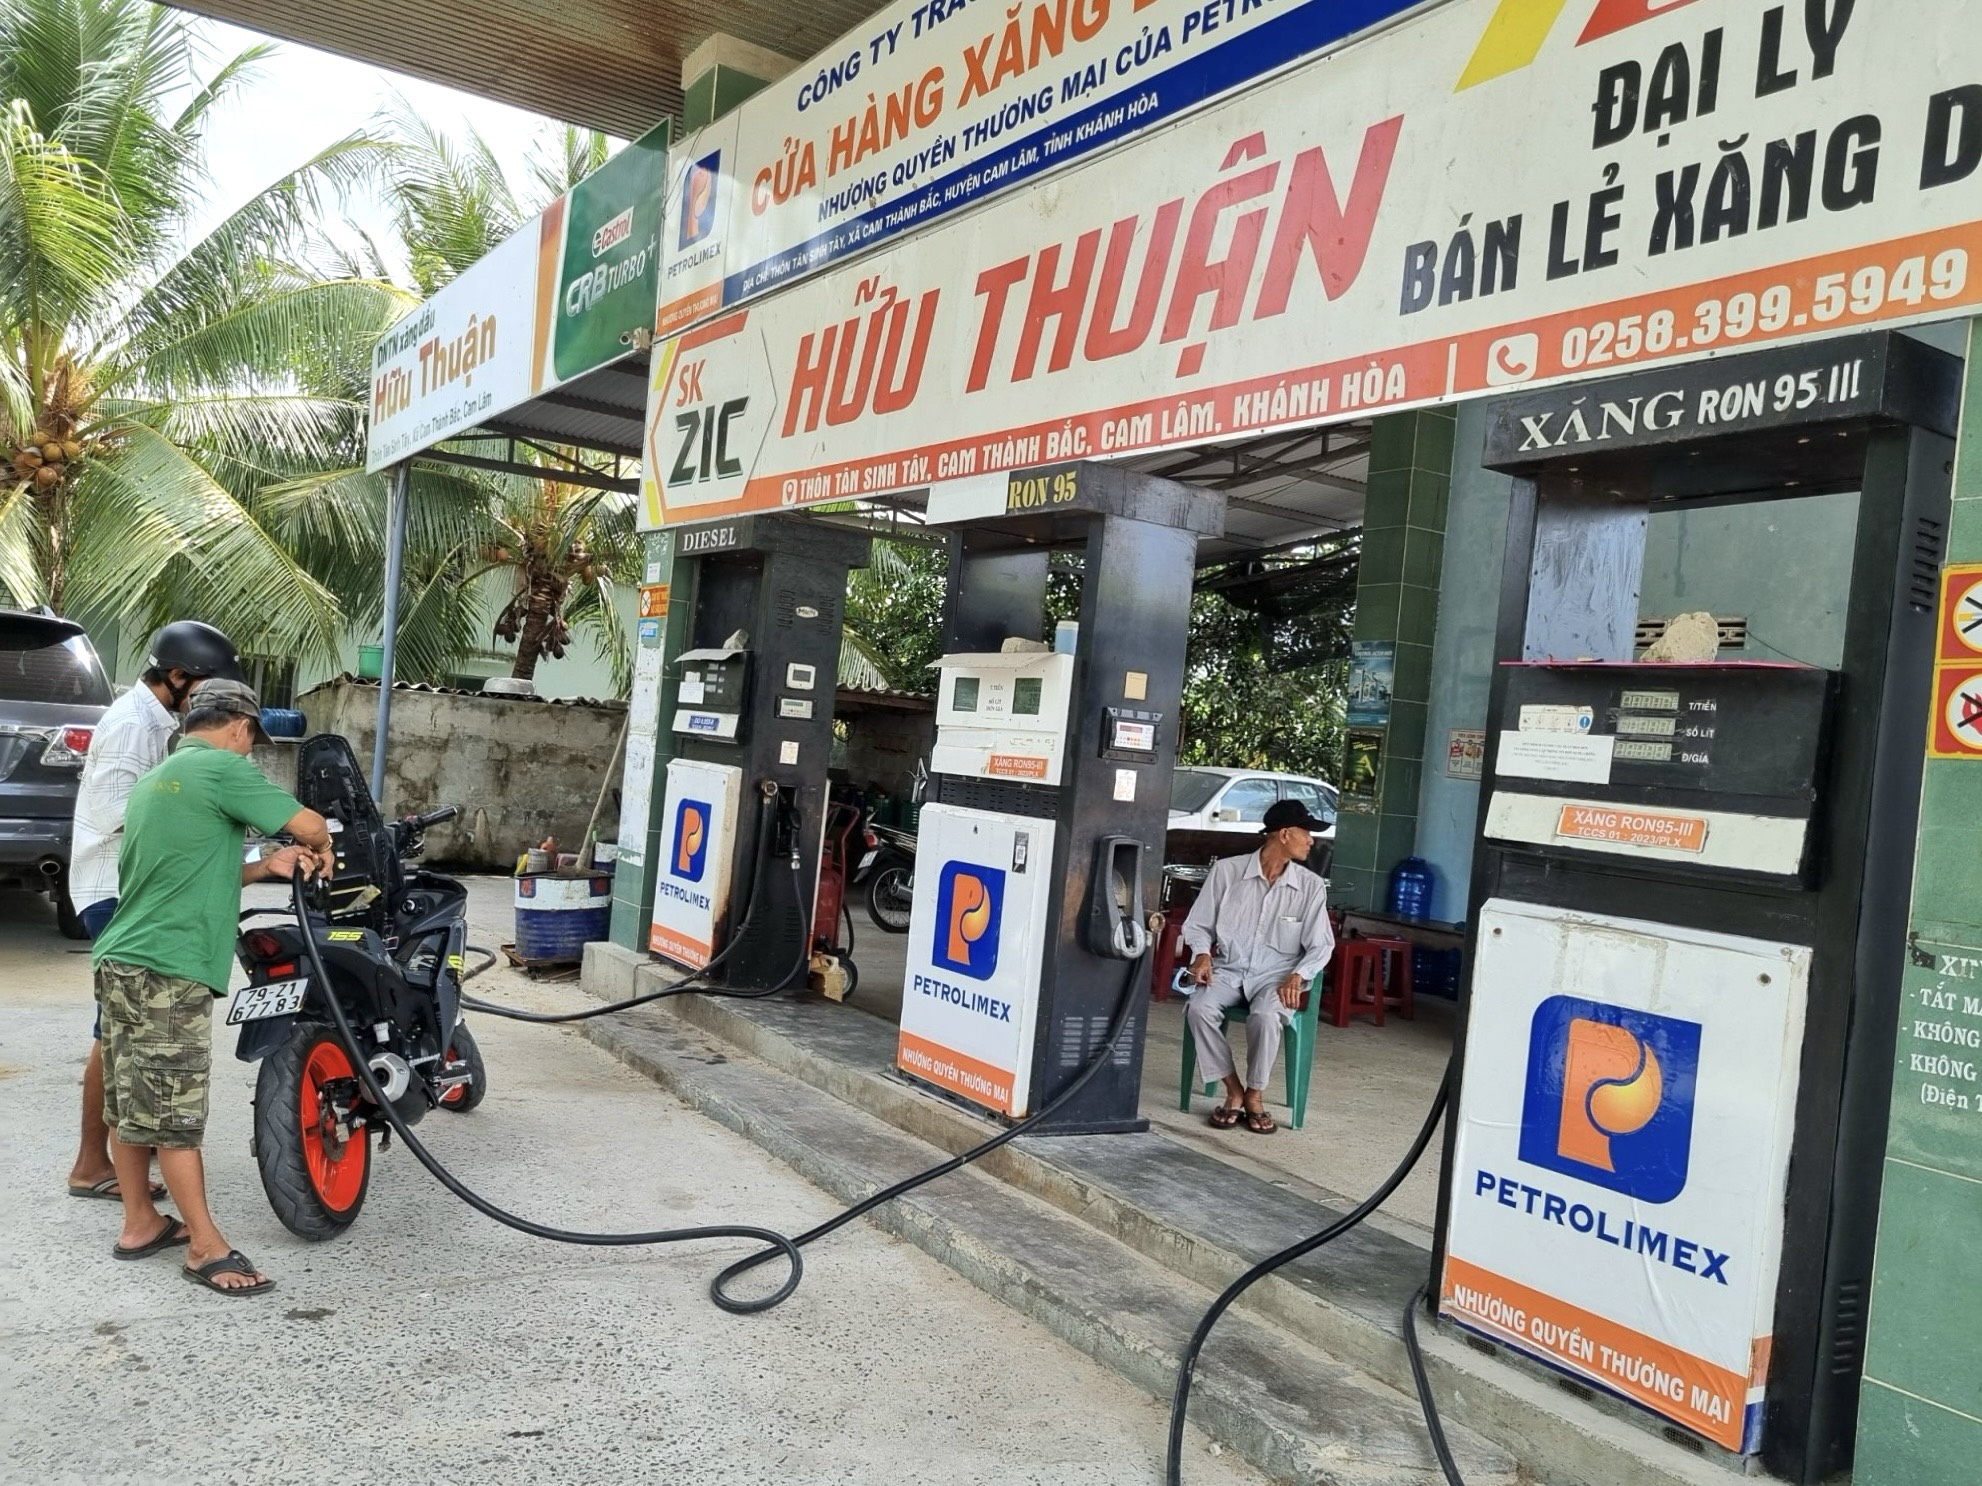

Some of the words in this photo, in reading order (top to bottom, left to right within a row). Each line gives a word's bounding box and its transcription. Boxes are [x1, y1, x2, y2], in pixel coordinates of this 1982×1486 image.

[797, 51, 861, 112] CÔNG
[870, 21, 903, 66] TY
[1591, 26, 1723, 150] ĐẠI
[752, 136, 817, 216] CỬA
[828, 66, 945, 178] HÀNG
[957, 0, 1110, 110] XĂNG
[892, 135, 956, 190] QUYỀN
[963, 86, 1053, 152] THƯƠNG
[1061, 57, 1106, 103] MẠI
[1116, 25, 1172, 76] CỦA
[863, 219, 883, 239] CAM
[886, 205, 918, 229] THÀNH
[945, 173, 981, 205] HUYỆN
[983, 161, 1009, 185] CAM
[1044, 131, 1073, 157] TỈNH
[1076, 107, 1124, 144] KHÁNH
[1127, 92, 1159, 120] HÒA
[1400, 212, 1522, 316] BÁN
[1546, 162, 1625, 282] LẺ
[1648, 114, 1882, 257] XĂNG
[667, 241, 722, 280] PETROLIMEX
[781, 275, 941, 440] HỮU
[966, 113, 1405, 394] THUẬN
[1561, 248, 1969, 370] 0258.399.5949
[374, 366, 412, 427] Hữu
[419, 313, 497, 398] Thuận
[676, 359, 706, 407] SK
[1697, 379, 1766, 425] RON
[1773, 371, 1818, 411] 95
[667, 395, 751, 488] ZIC
[800, 474, 831, 501] THÔN
[834, 466, 859, 495] TÂN
[863, 461, 897, 491] SINH
[938, 447, 977, 478] CAM
[983, 435, 1040, 471] THÀNH
[1101, 413, 1153, 450] CAM
[1161, 400, 1222, 441] LÂM,
[1232, 378, 1330, 429] KHÁNH
[1340, 361, 1406, 409] HÒA
[1008, 480, 1050, 510] RON
[1053, 471, 1078, 503] 95
[682, 527, 737, 552] DIESEL
[1573, 808, 1617, 828] XĂNG
[1621, 815, 1694, 837] RON95-III
[1578, 826, 1606, 839] TCCS
[1609, 830, 1620, 840] 01
[1630, 833, 1683, 848] 2023/PLX
[660, 882, 711, 911] PETROLIMEX
[328, 931, 364, 941] 155
[232, 995, 300, 1022] 677.83
[246, 982, 297, 1004] 79-Z1
[913, 974, 1012, 1023] PETROLIMEX
[1920, 981, 1957, 1011] TẮT
[1913, 1020, 1981, 1049] KHÔNG
[1910, 1053, 1978, 1081] KHÔNG
[1475, 1169, 1731, 1286] PETROLIMEX
[1531, 1318, 1595, 1364] QUYỀN
[1600, 1345, 1685, 1402] THƯƠNG
[1691, 1385, 1732, 1425] MẠI
